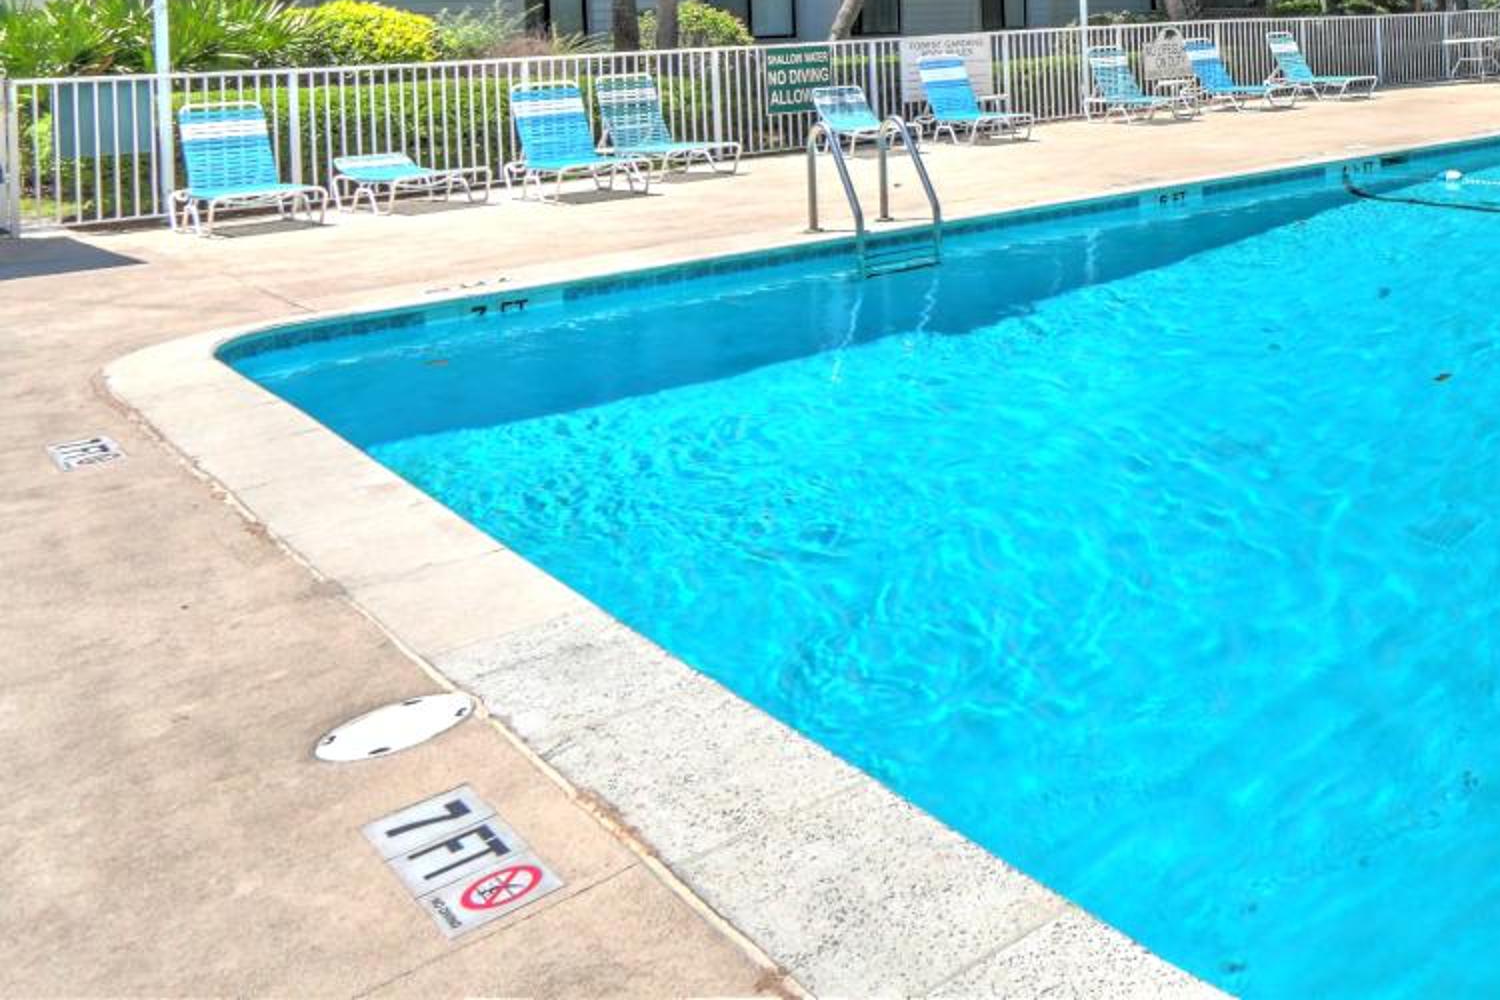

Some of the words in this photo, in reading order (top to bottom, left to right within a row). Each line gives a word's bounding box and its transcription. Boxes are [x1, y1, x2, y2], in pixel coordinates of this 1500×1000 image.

[768, 53, 803, 65] SHALLOW
[804, 51, 829, 63] WATER
[767, 69, 787, 85] NO
[789, 67, 830, 84] DIVING
[770, 87, 815, 106] ALLOW
[384, 798, 472, 838] 7
[407, 823, 511, 881] FT
